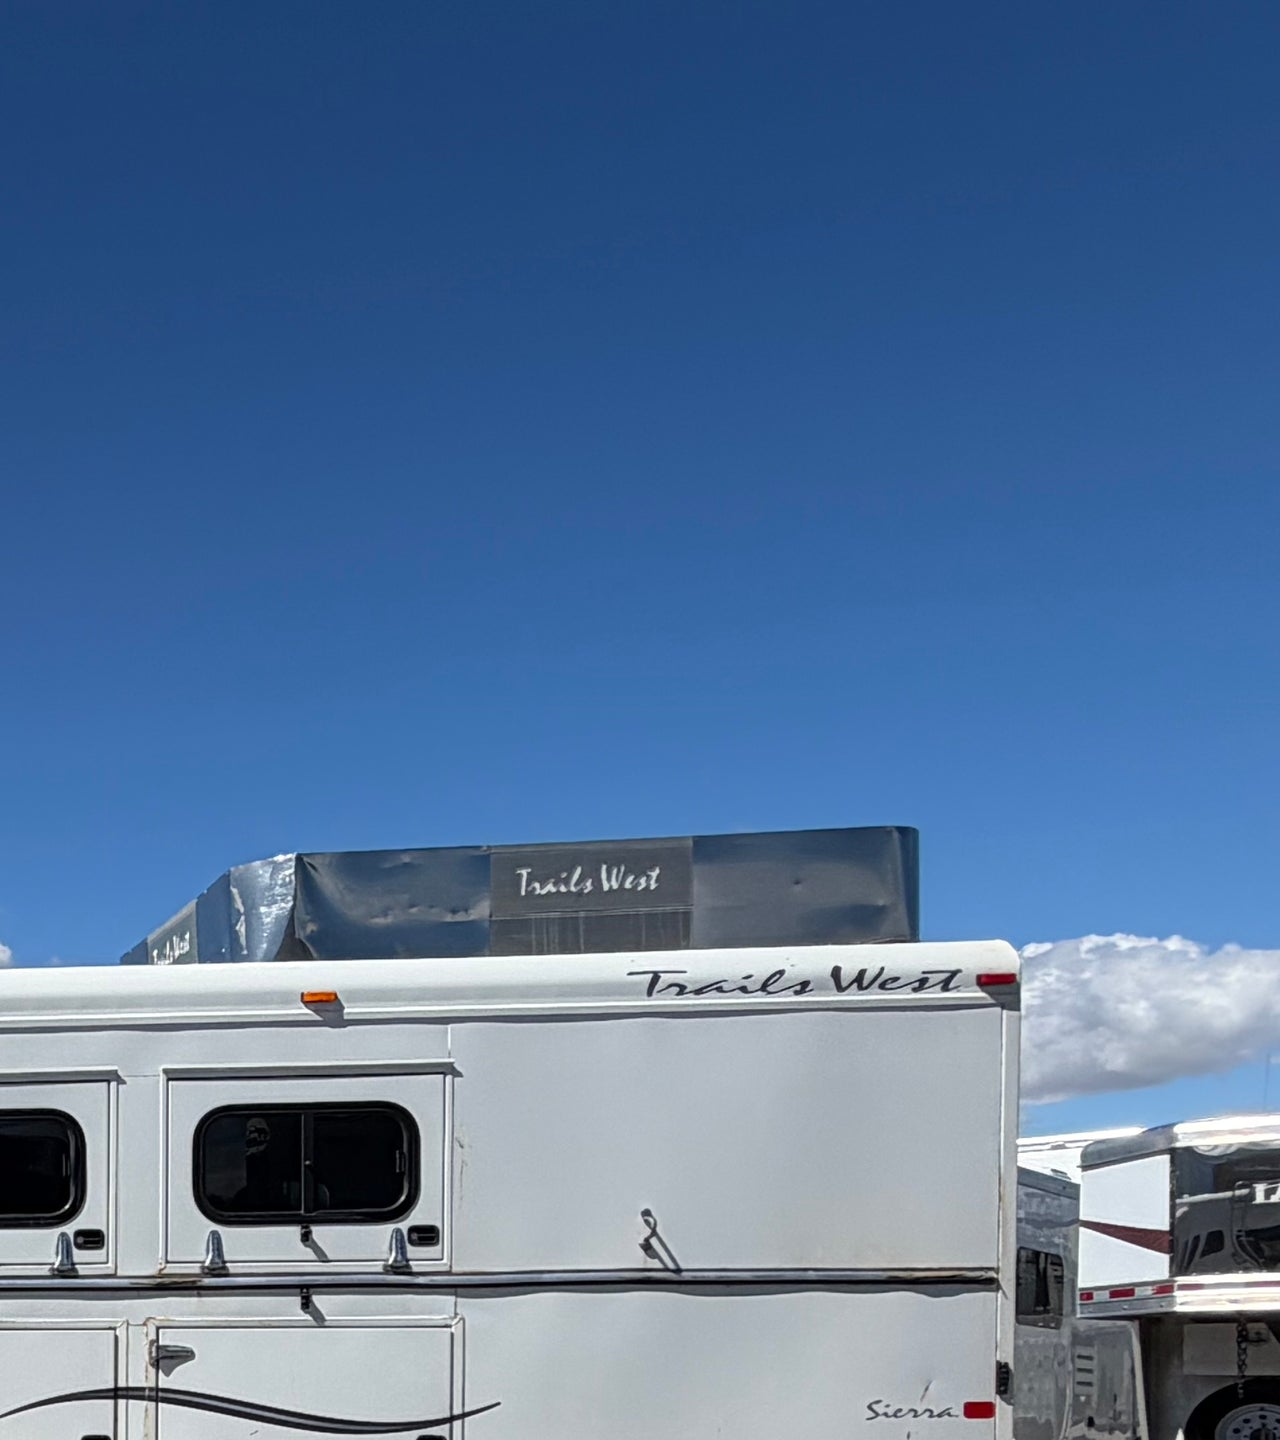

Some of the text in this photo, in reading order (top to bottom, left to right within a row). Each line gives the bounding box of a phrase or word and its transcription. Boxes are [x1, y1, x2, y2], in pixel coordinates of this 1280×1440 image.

[515, 864, 660, 896] Trails West
[627, 965, 963, 998] Trails West
[865, 1399, 960, 1420] Sierra
